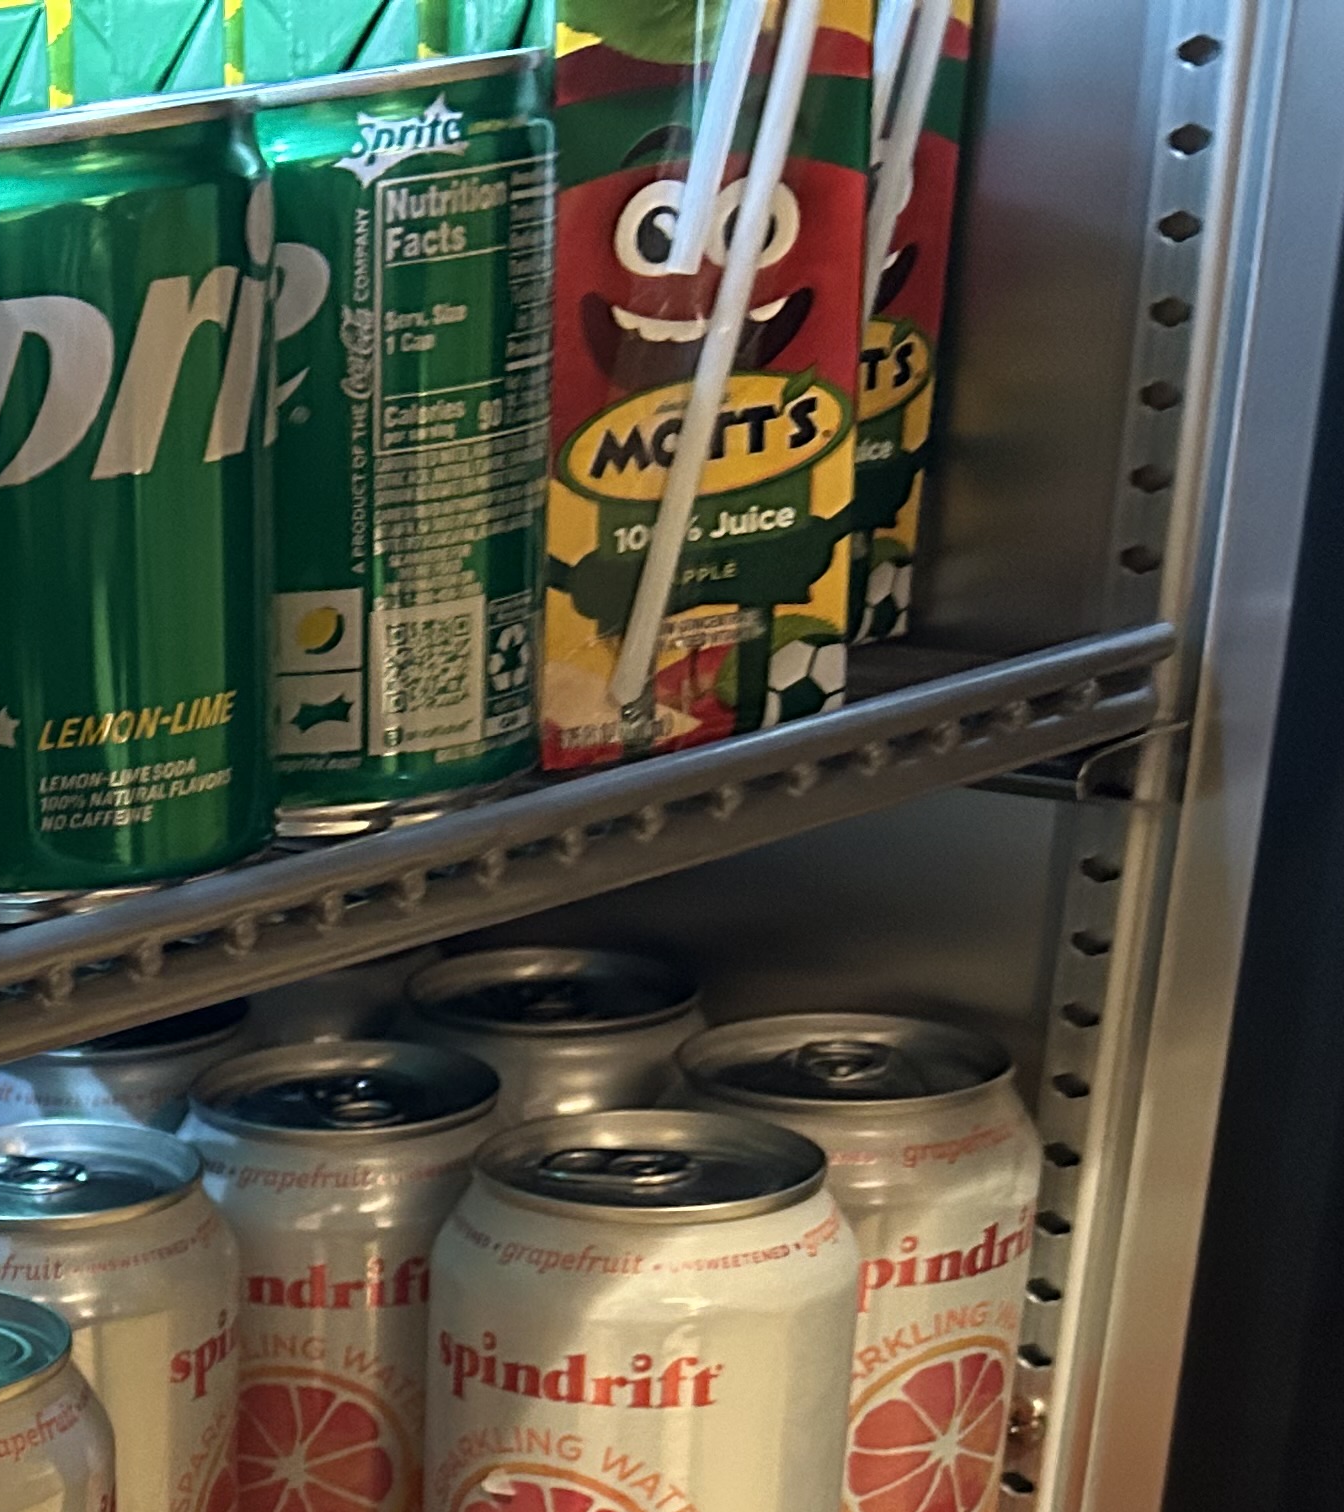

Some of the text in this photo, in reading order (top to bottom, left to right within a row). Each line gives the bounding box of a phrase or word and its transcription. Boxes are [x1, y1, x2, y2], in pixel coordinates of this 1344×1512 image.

[351, 112, 464, 167] Sprite
[385, 176, 508, 224] Nutrition
[385, 221, 468, 262] Facts
[612, 505, 798, 554] 10% Juice
[37, 688, 238, 752] LEMON-LIME
[38, 757, 197, 795] LEMON-LIME SODA
[89, 779, 169, 808] NATURAL
[40, 815, 66, 834] NO
[237, 1163, 376, 1193] grapefruit
[495, 1240, 792, 1276] grapefruit UNSWEETENED
[437, 1330, 725, 1410] spindrift
